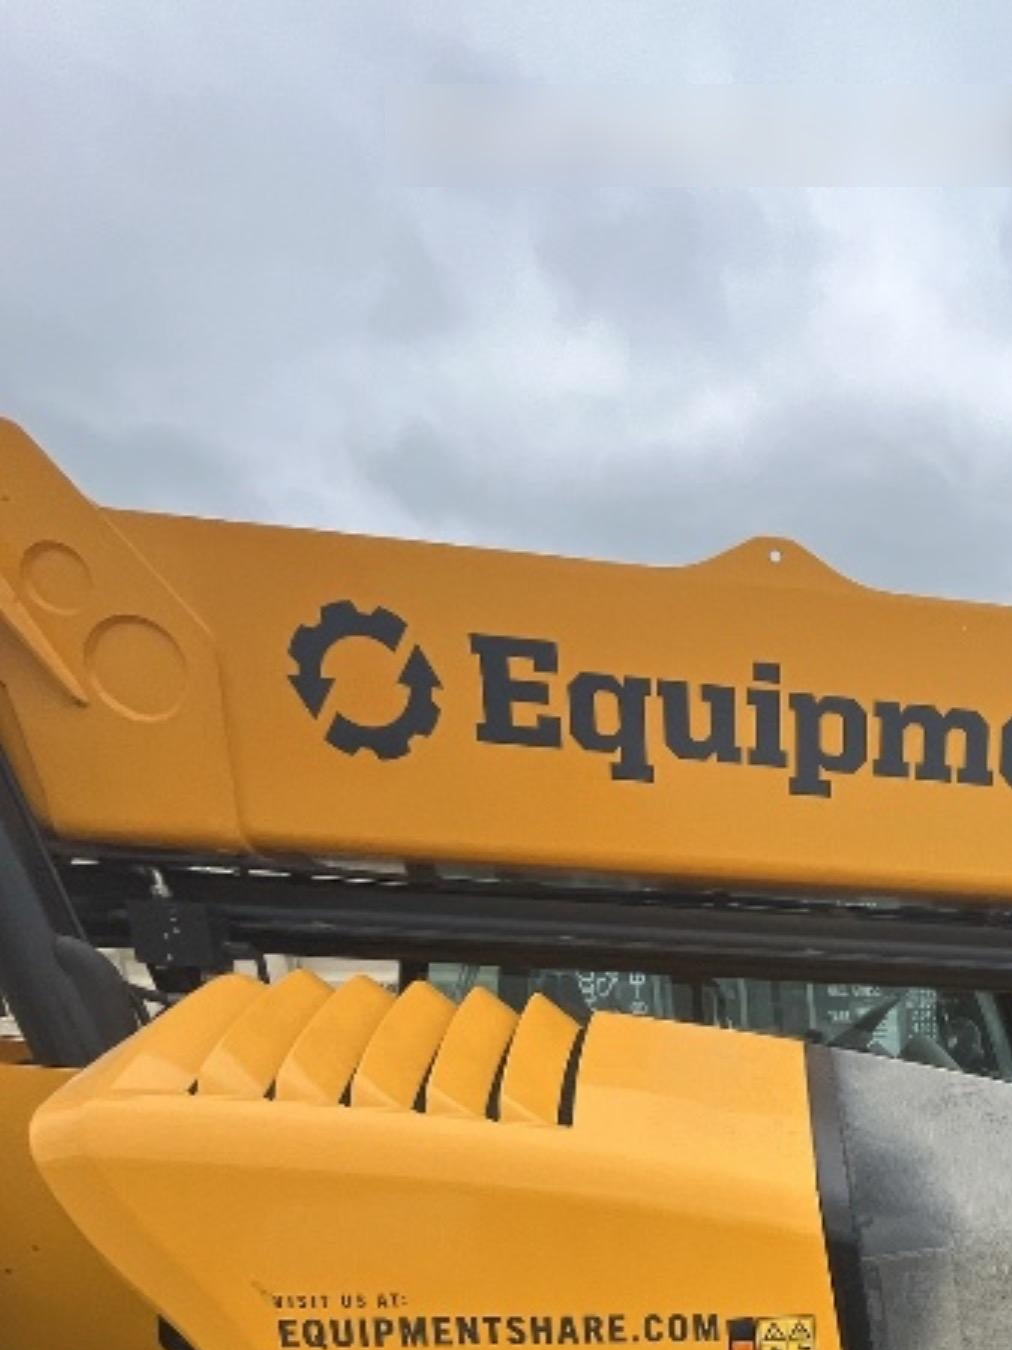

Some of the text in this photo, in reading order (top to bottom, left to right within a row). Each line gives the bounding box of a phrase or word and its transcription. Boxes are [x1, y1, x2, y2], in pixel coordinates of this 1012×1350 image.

[272, 1294, 328, 1309] VISIT
[341, 1294, 366, 1308] US
[277, 1313, 719, 1350] EQUIPMENTSHARE.COM
